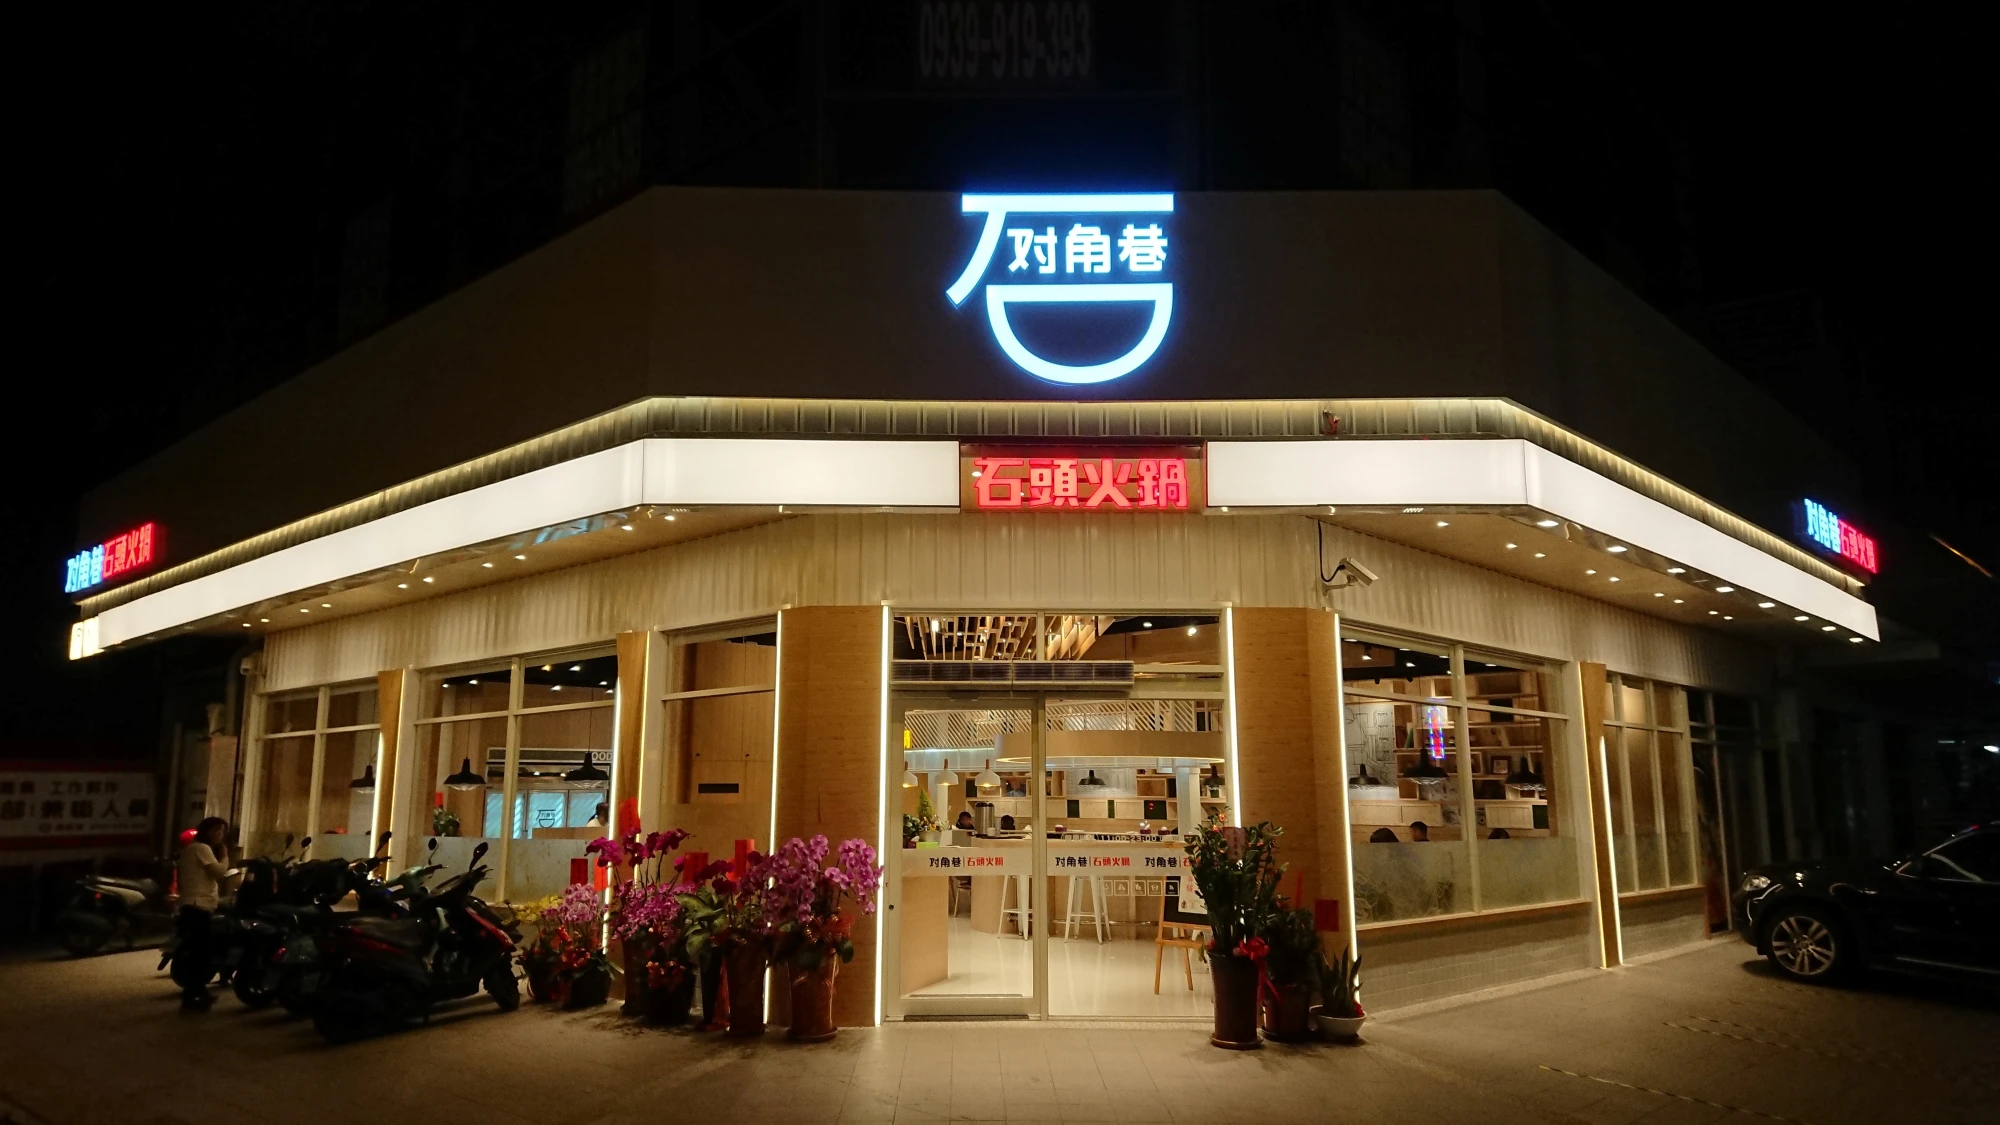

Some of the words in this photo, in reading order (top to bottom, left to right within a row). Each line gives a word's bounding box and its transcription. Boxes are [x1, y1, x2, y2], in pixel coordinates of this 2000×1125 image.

[919, 1, 1092, 78] 0939-919-393
[1007, 223, 1168, 274] 对角巷
[974, 457, 1188, 507] 石頭火鍋
[103, 523, 153, 579] 石頭火鍋
[929, 857, 962, 868] 对角巷
[967, 856, 1004, 867] 石頭火鍋
[1055, 856, 1088, 868] 对角巷
[1093, 856, 1131, 867] 石頭火鍋
[1145, 856, 1178, 868] 对角巷
